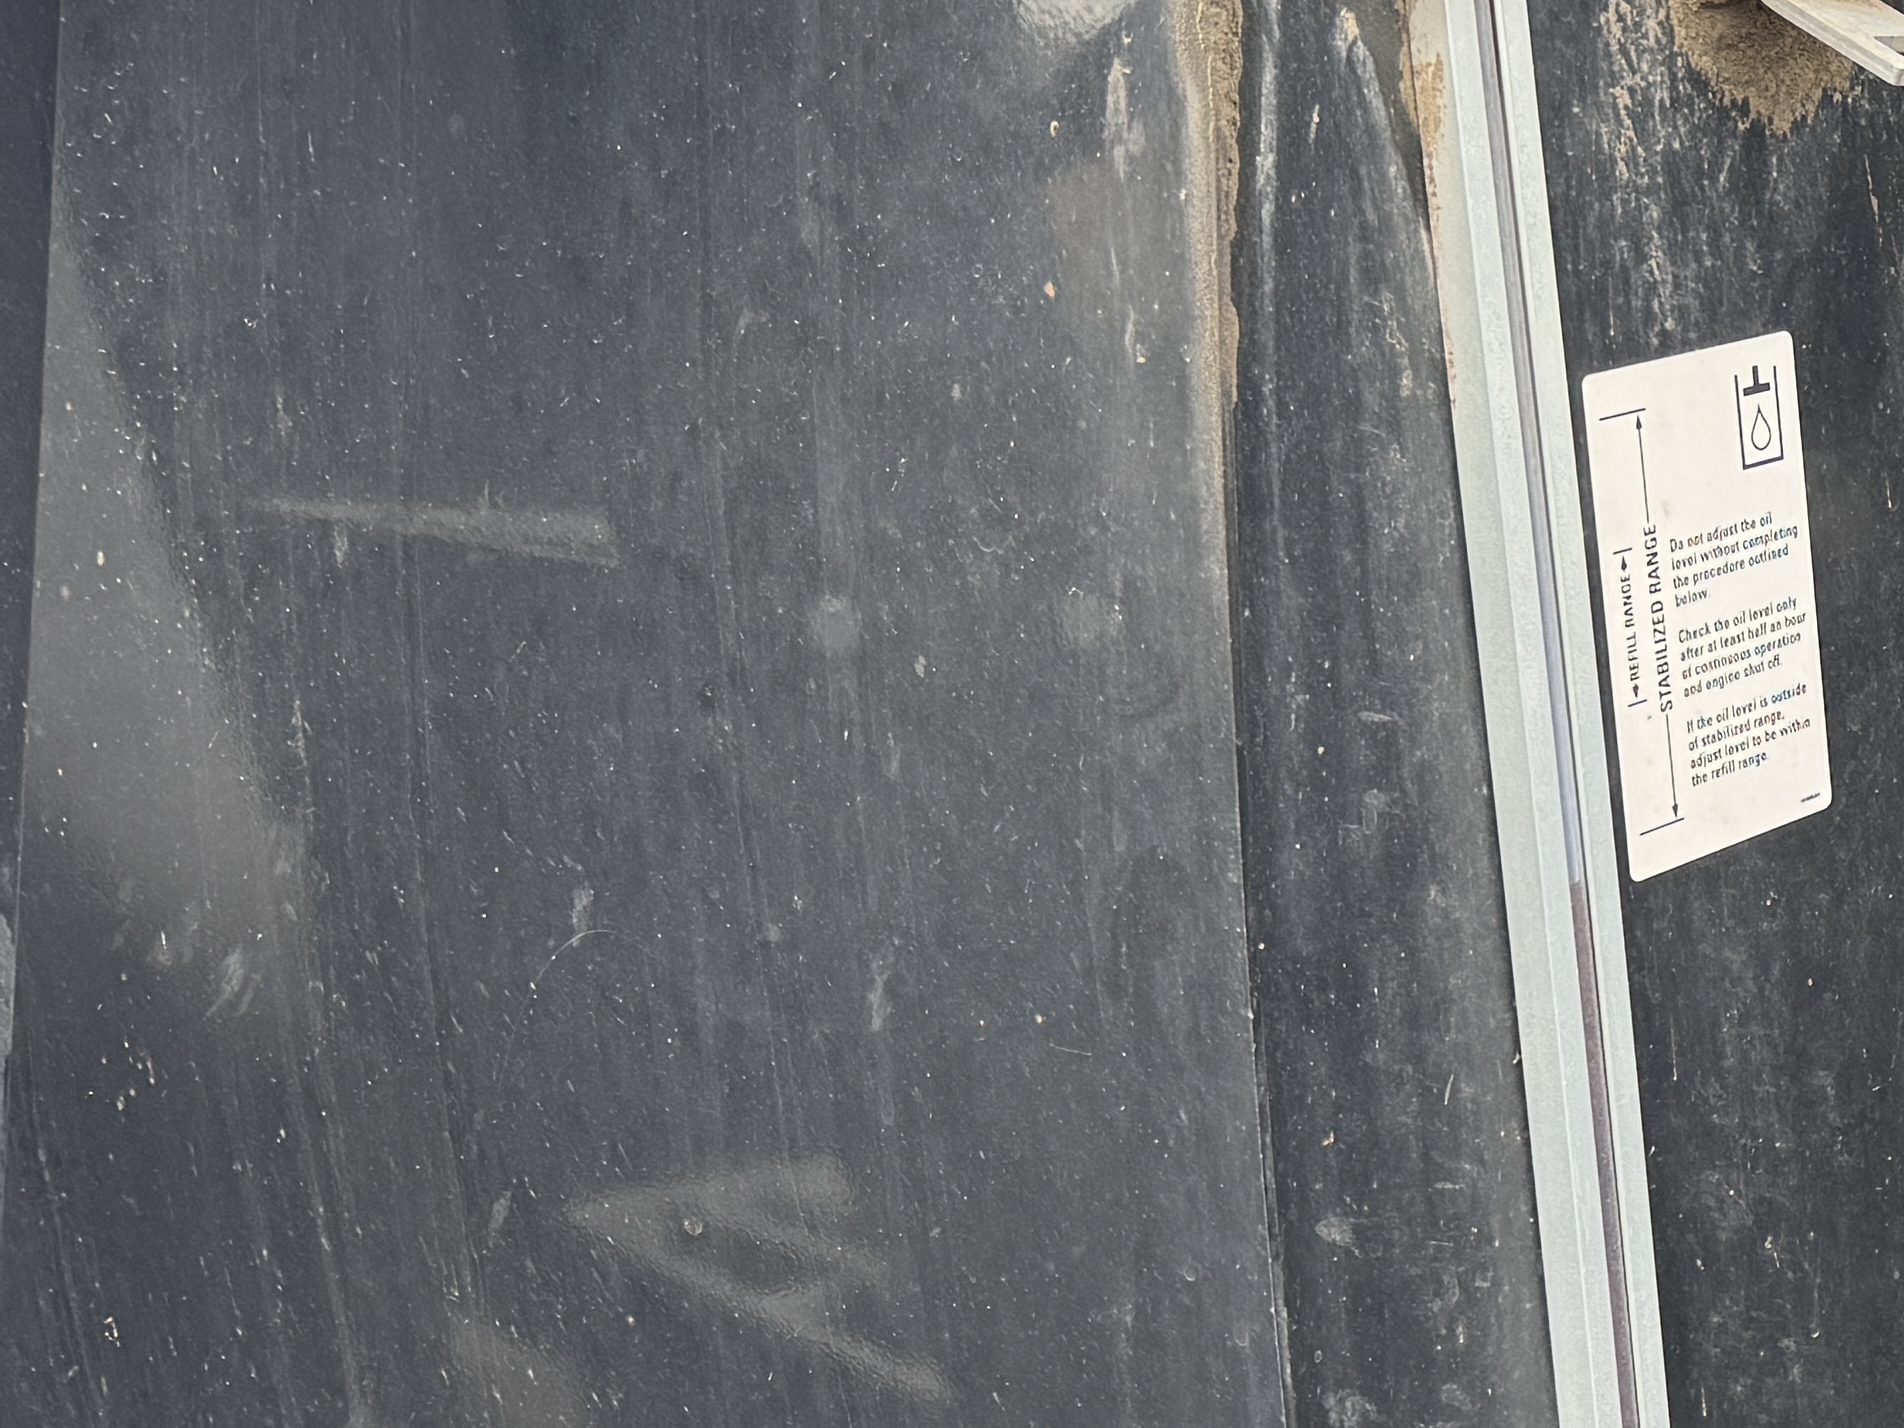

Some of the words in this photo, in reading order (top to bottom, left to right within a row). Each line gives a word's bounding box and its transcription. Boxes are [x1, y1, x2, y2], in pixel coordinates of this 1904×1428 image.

[1669, 538, 1684, 553] Do
[1687, 532, 1704, 547] not
[1707, 523, 1738, 542] adjust
[1740, 518, 1756, 532] the
[1759, 511, 1772, 527] oil
[1643, 525, 1662, 594] RANGE
[1671, 552, 1697, 571] level
[1700, 541, 1740, 562] without
[1672, 575, 1689, 590] the
[1692, 559, 1745, 586] procedure
[1620, 574, 1635, 629] RANGE
[1678, 622, 1712, 644] Check
[1714, 619, 1730, 632] the
[1732, 610, 1746, 627] oil
[1748, 602, 1774, 622] level
[1776, 596, 1797, 613] only
[1626, 632, 1640, 681] REFILL
[1651, 600, 1673, 712] STABILIZED
[1680, 645, 1704, 662] after
[1707, 639, 1717, 653] at
[1720, 631, 1745, 649] least
[1747, 622, 1767, 640] half
[1770, 620, 1782, 633] an
[1754, 632, 1801, 658] operation
[1684, 679, 1702, 698] and
[1705, 670, 1740, 690] engine
[1743, 660, 1765, 678] shut
[1696, 716, 1713, 730] the
[1716, 707, 1729, 723] oil
[1731, 698, 1757, 718] level
[1759, 697, 1768, 708] is
[1771, 682, 1806, 704] outside
[1690, 748, 1722, 769] adjust
[1724, 736, 1750, 756] level
[1752, 735, 1762, 747] to
[1764, 730, 1777, 742] be
[1779, 718, 1810, 736] within
[1701, 718, 1751, 747] stabilized
[1691, 773, 1708, 787] the
[1711, 759, 1736, 780] refill
